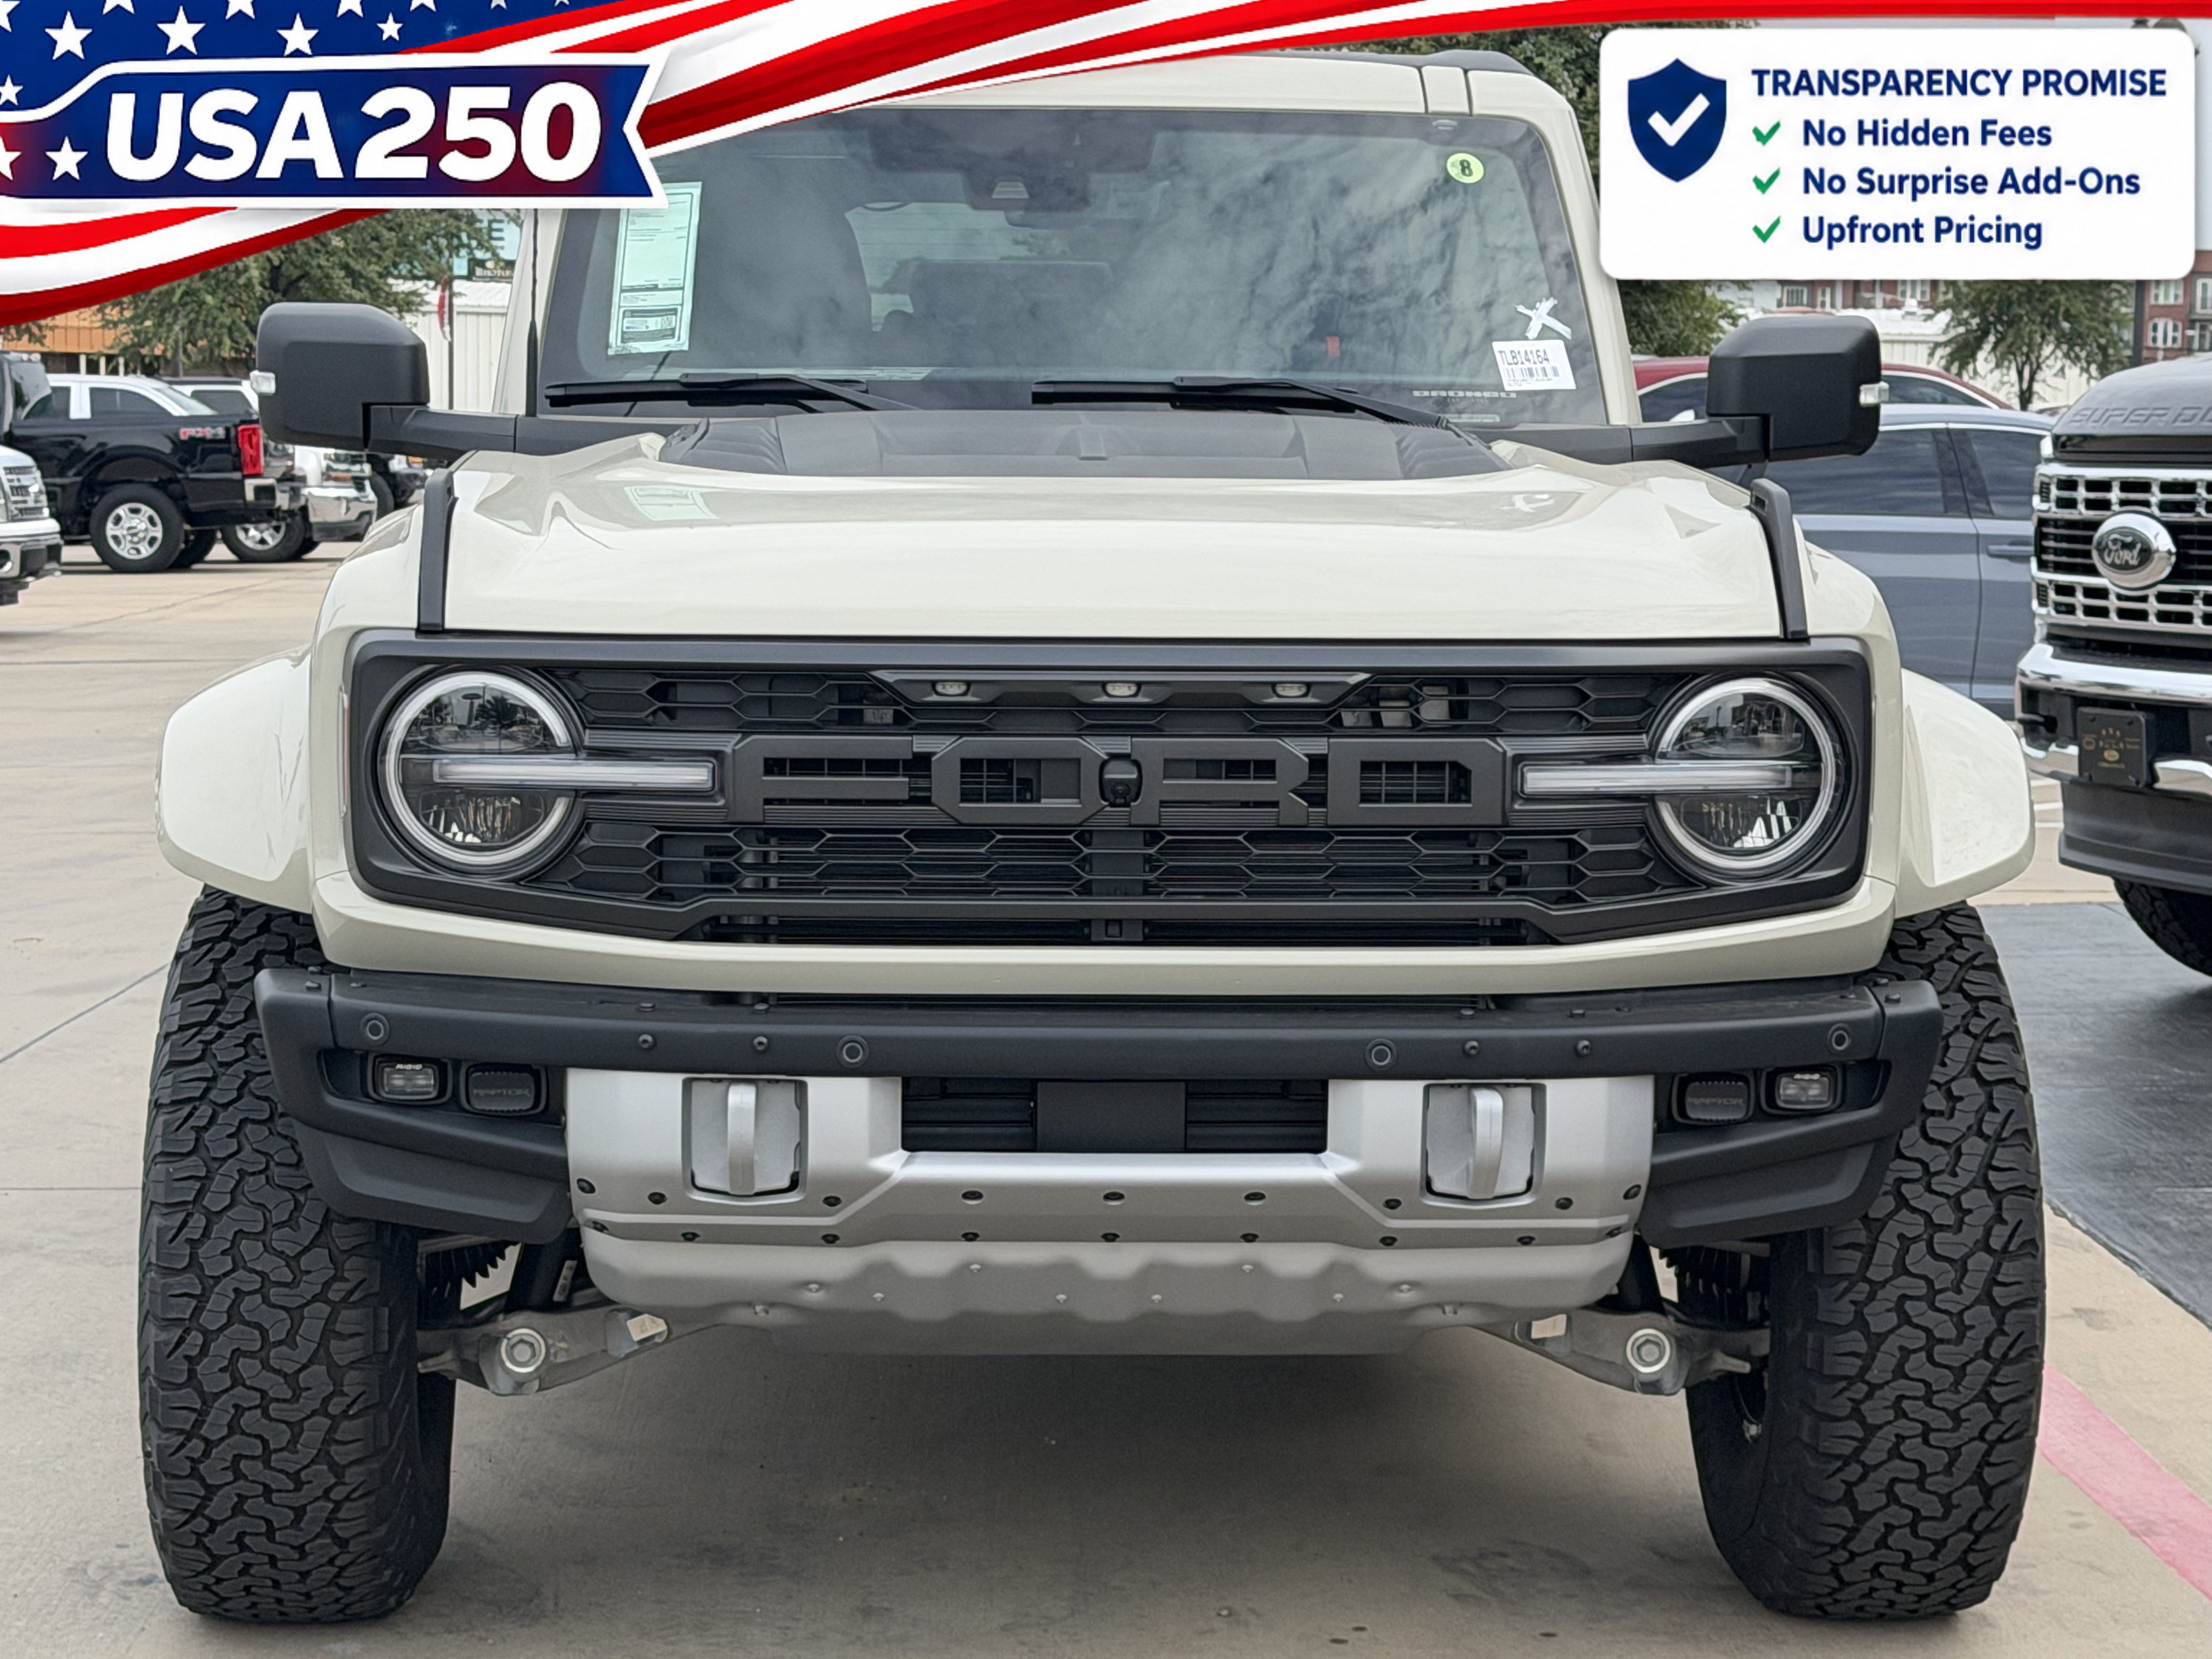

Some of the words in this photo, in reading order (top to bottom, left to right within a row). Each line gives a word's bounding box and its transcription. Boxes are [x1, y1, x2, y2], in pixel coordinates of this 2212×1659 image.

[1459, 159, 1474, 177] 8
[1497, 349, 1550, 365] TLB14164
[2068, 407, 2171, 425] SUPER
[2103, 533, 2142, 566] Ford
[735, 736, 1505, 827] FORD
